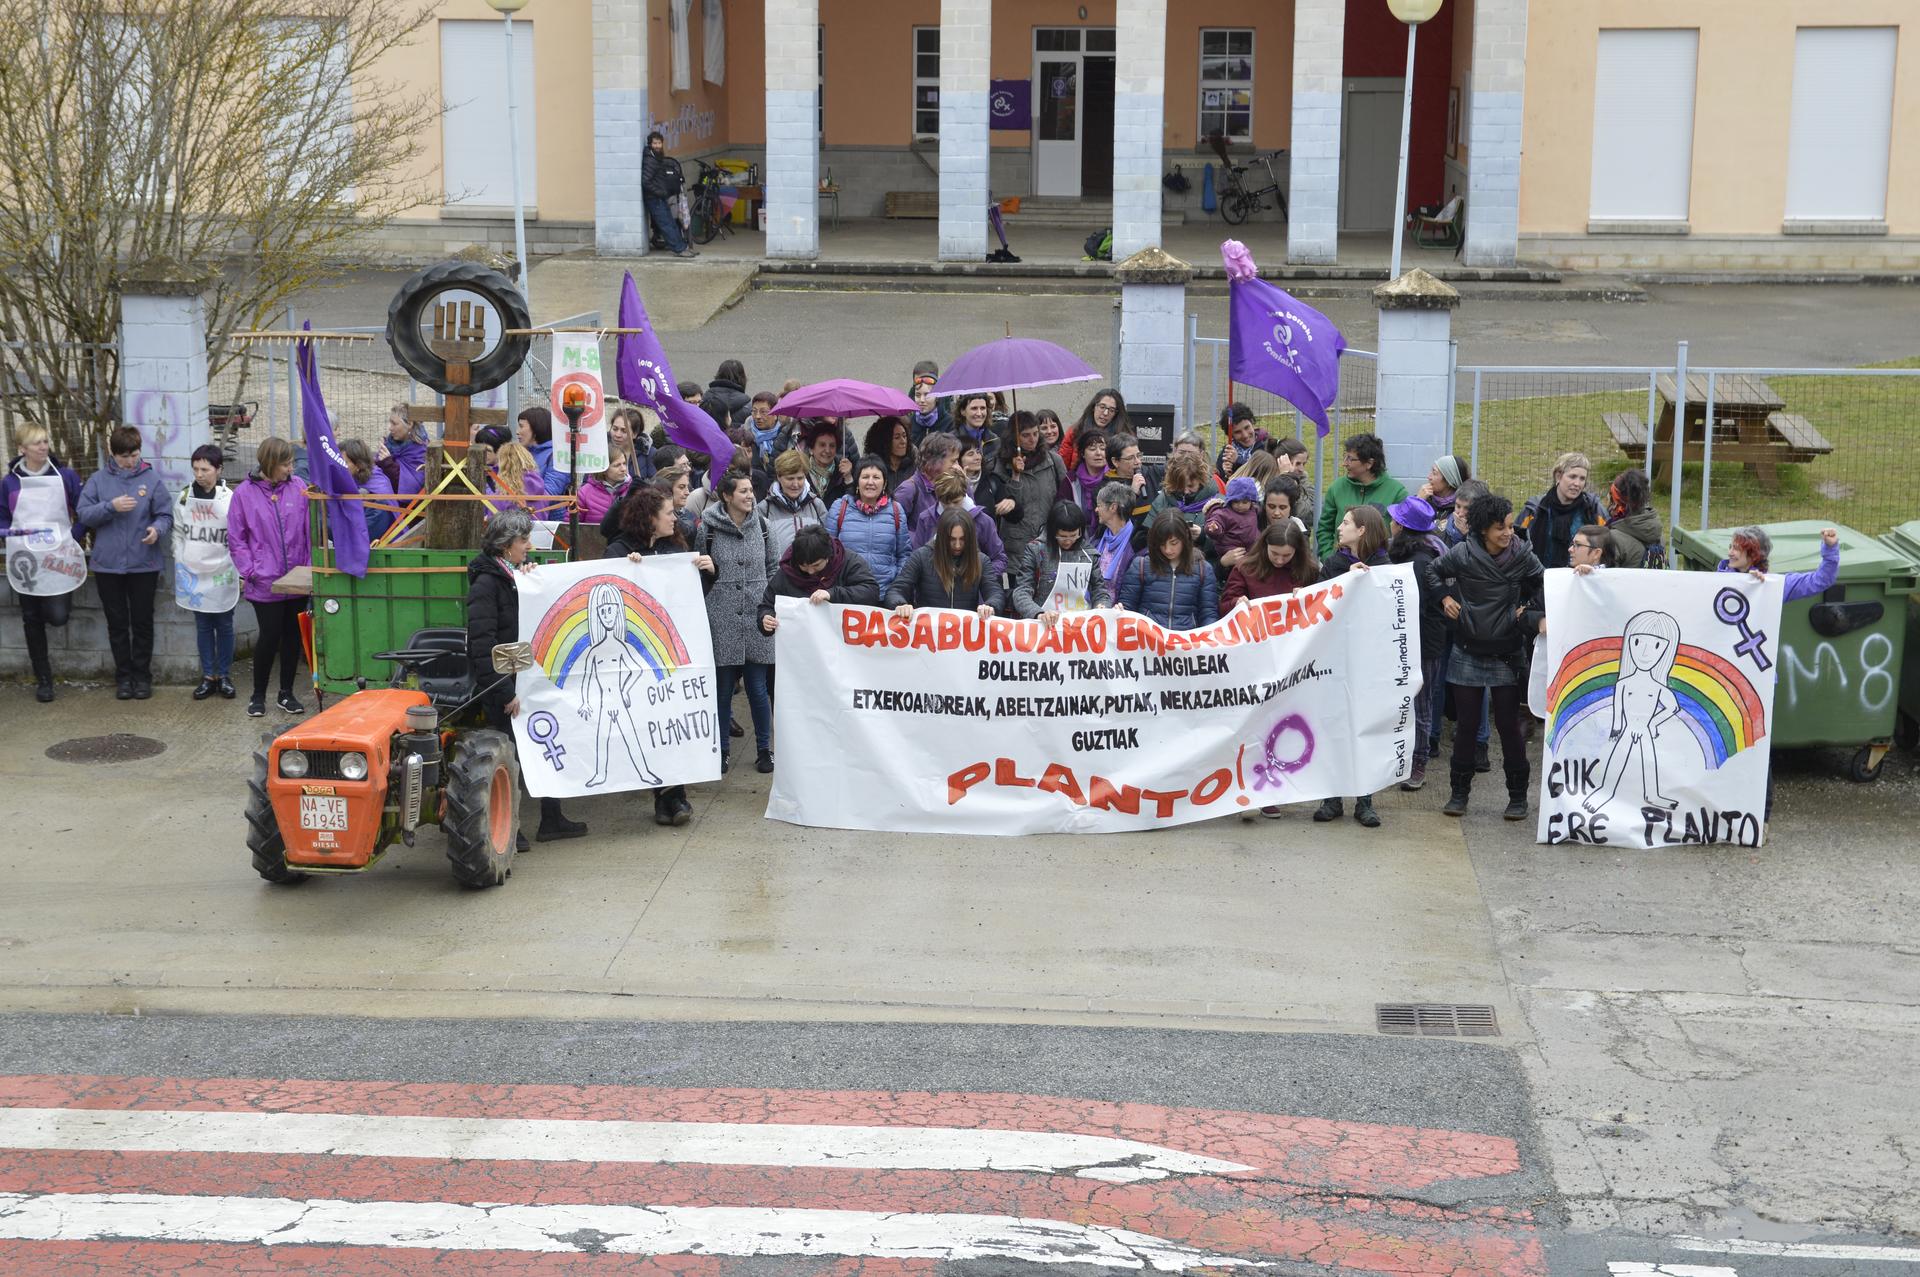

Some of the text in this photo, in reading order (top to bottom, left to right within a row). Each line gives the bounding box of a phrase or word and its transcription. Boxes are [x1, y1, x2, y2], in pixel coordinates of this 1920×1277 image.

[1389, 578, 1406, 630] Feminista
[842, 608, 1107, 654] BASABURUAKO
[978, 653, 1230, 685] BOLLERAK, TRANSAK, LANGILEAK
[647, 675, 709, 706] GUK ERE
[853, 689, 991, 720] ETXEKOANDREAK,
[648, 709, 717, 753] PLANTO!
[1072, 727, 1139, 752] GUZTIAK
[947, 743, 1250, 818] PLANTO!
[1547, 758, 1600, 798] GUK
[303, 813, 345, 828] 61945
[1547, 806, 1760, 848] ERE PLANTO
